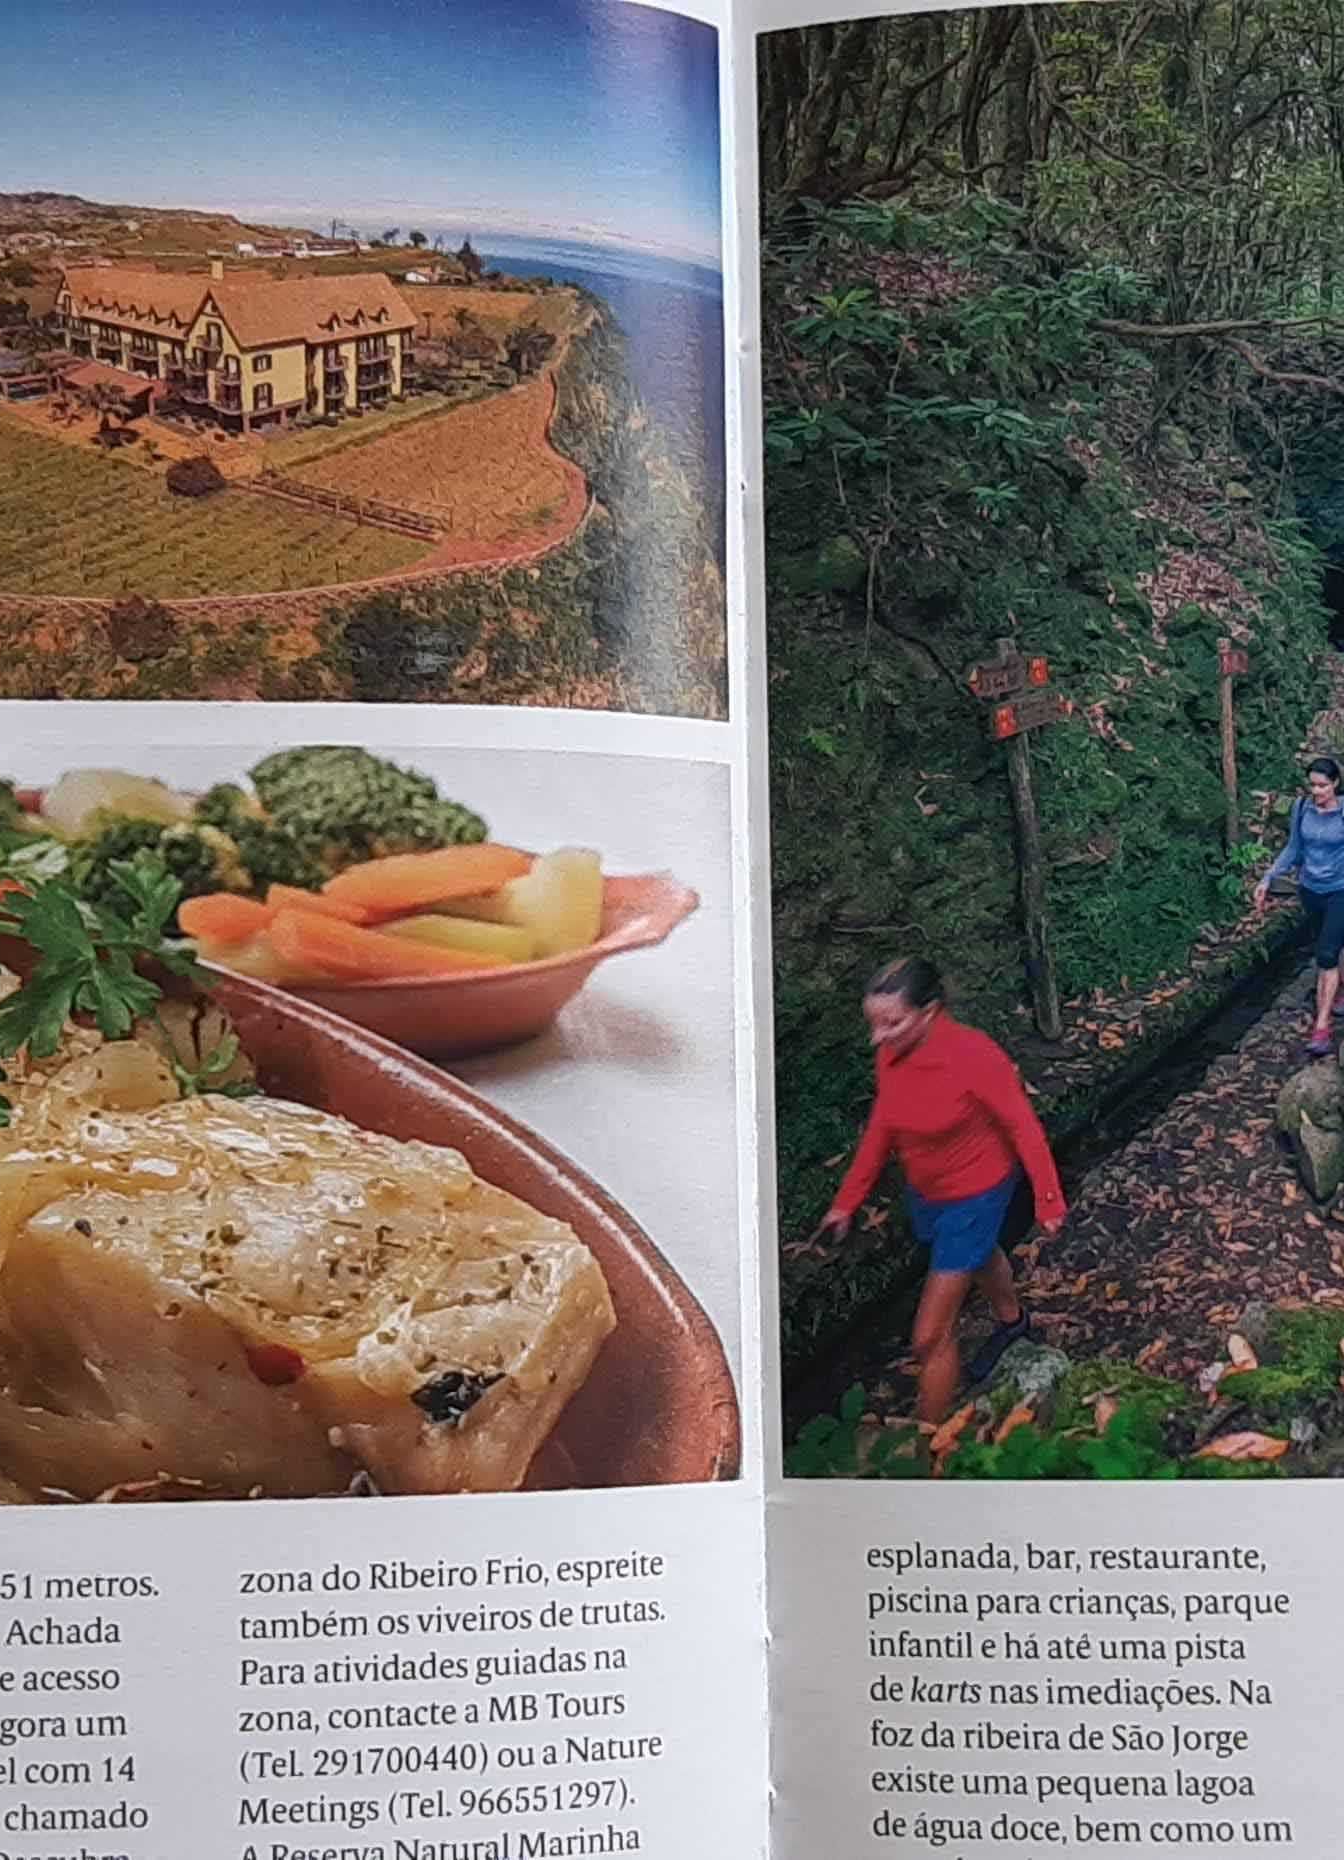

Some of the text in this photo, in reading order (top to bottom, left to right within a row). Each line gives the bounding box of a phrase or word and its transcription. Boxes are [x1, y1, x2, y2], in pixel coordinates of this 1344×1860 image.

[240, 1551, 663, 1593] zona do Ribeiro Frio, espreite
[867, 1542, 1266, 1575] esplanada, bar, restaurante,
[44, 1575, 160, 1600] metros.
[869, 1586, 1289, 1622] piscina para crianças, parque
[6, 1616, 121, 1645] Achada
[240, 1646, 626, 1686] Para atividades guiadas na
[870, 1675, 1272, 1712] de karts nas imediações. Na
[239, 1693, 624, 1735] zona, contacte a MB Tours
[239, 1778, 635, 1829] Meetings (Tel. 966551297).
[872, 1766, 1255, 1804] existe uma pequena lagoa
[4, 1801, 148, 1831] chamado
